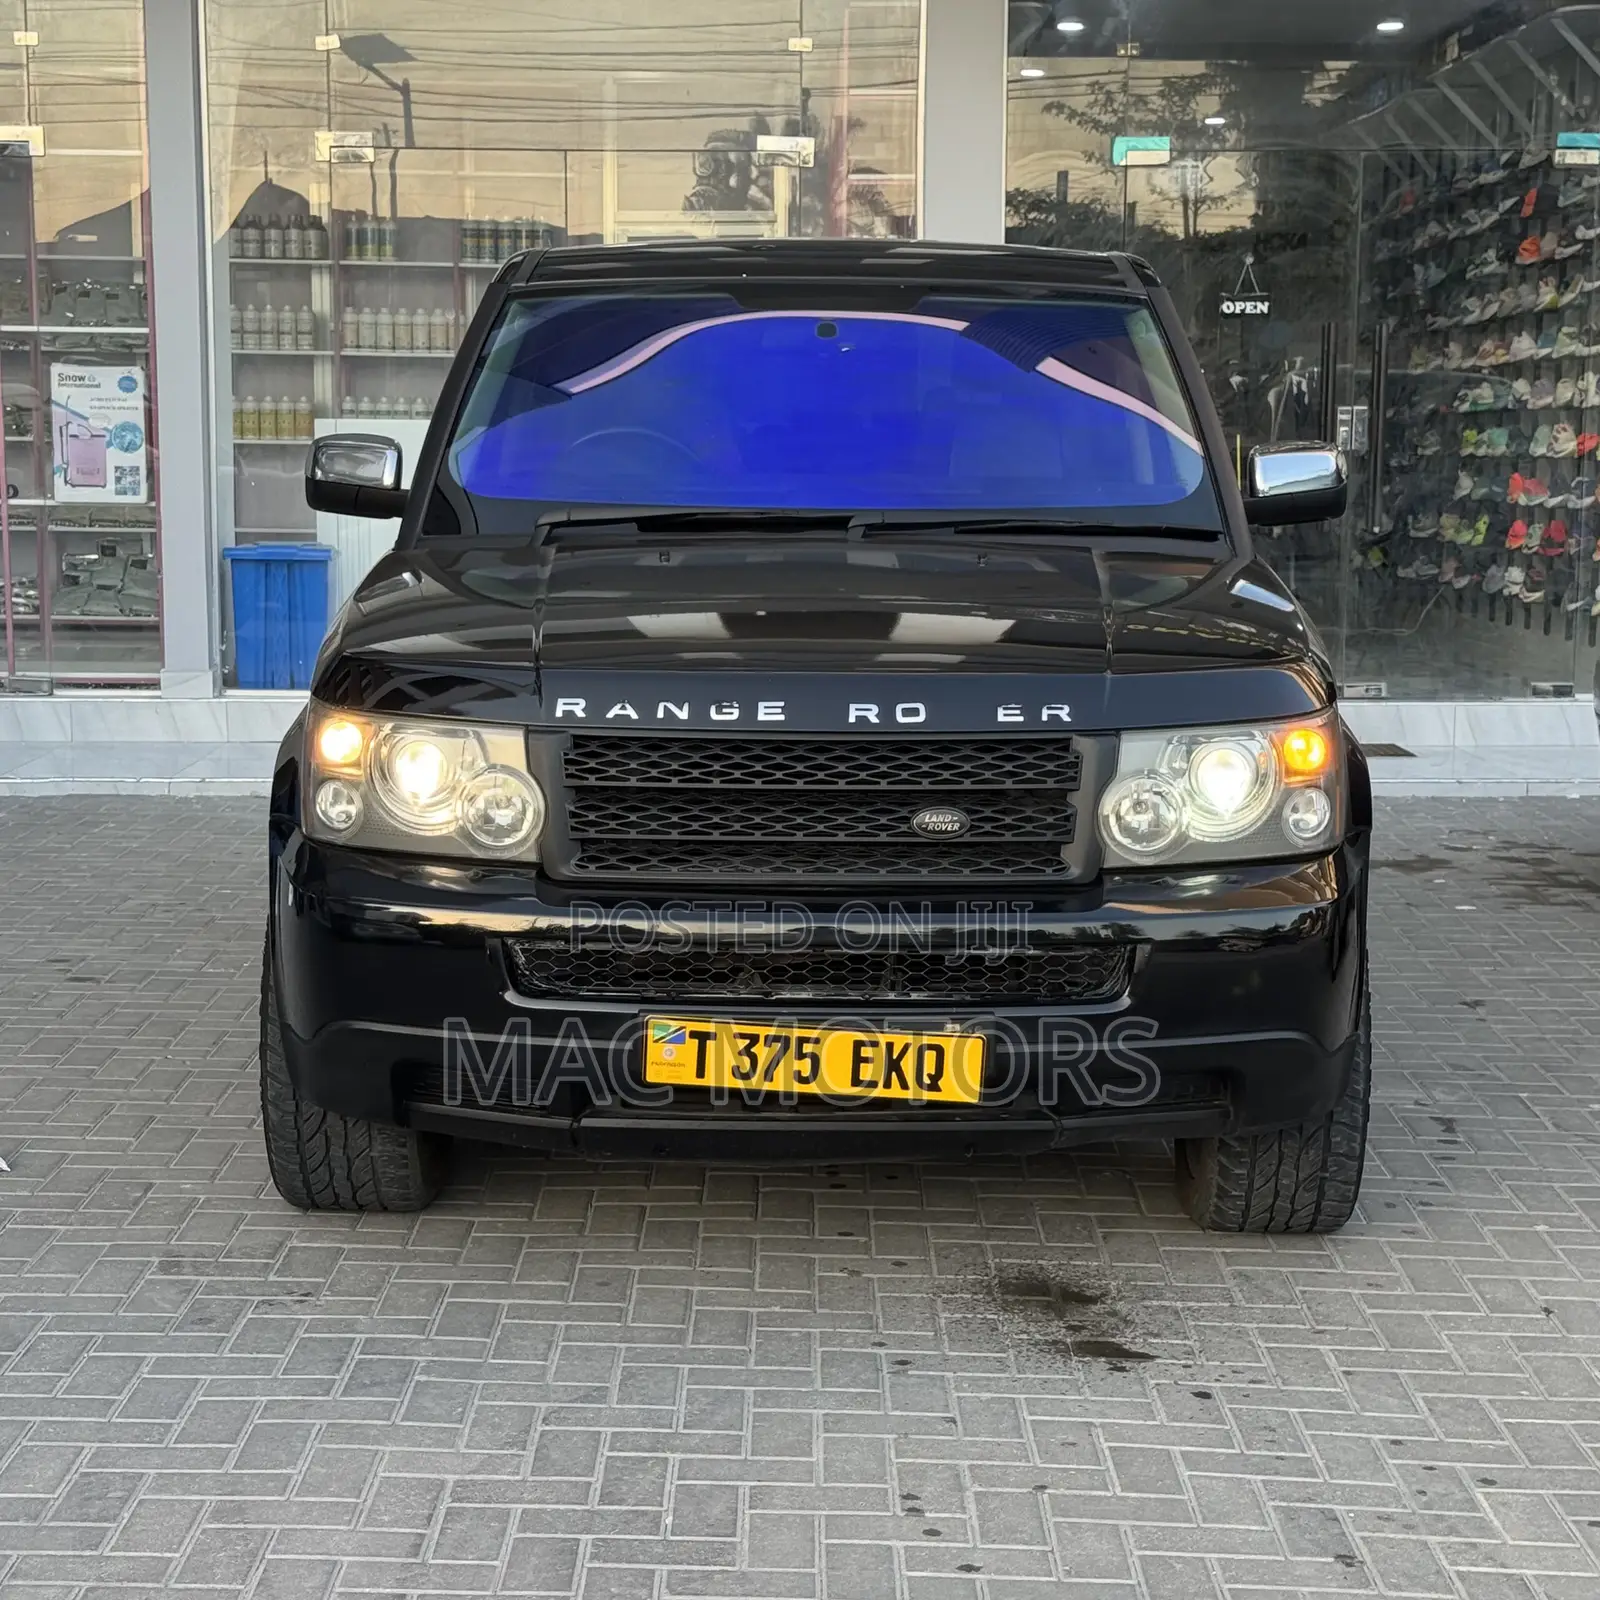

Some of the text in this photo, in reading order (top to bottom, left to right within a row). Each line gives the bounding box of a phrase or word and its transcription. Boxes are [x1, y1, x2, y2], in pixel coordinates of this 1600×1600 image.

[1222, 301, 1270, 314] OPEN
[57, 373, 87, 383] Snow
[554, 698, 786, 722] RANGE
[688, 1029, 945, 1092] T 375 EKQ
